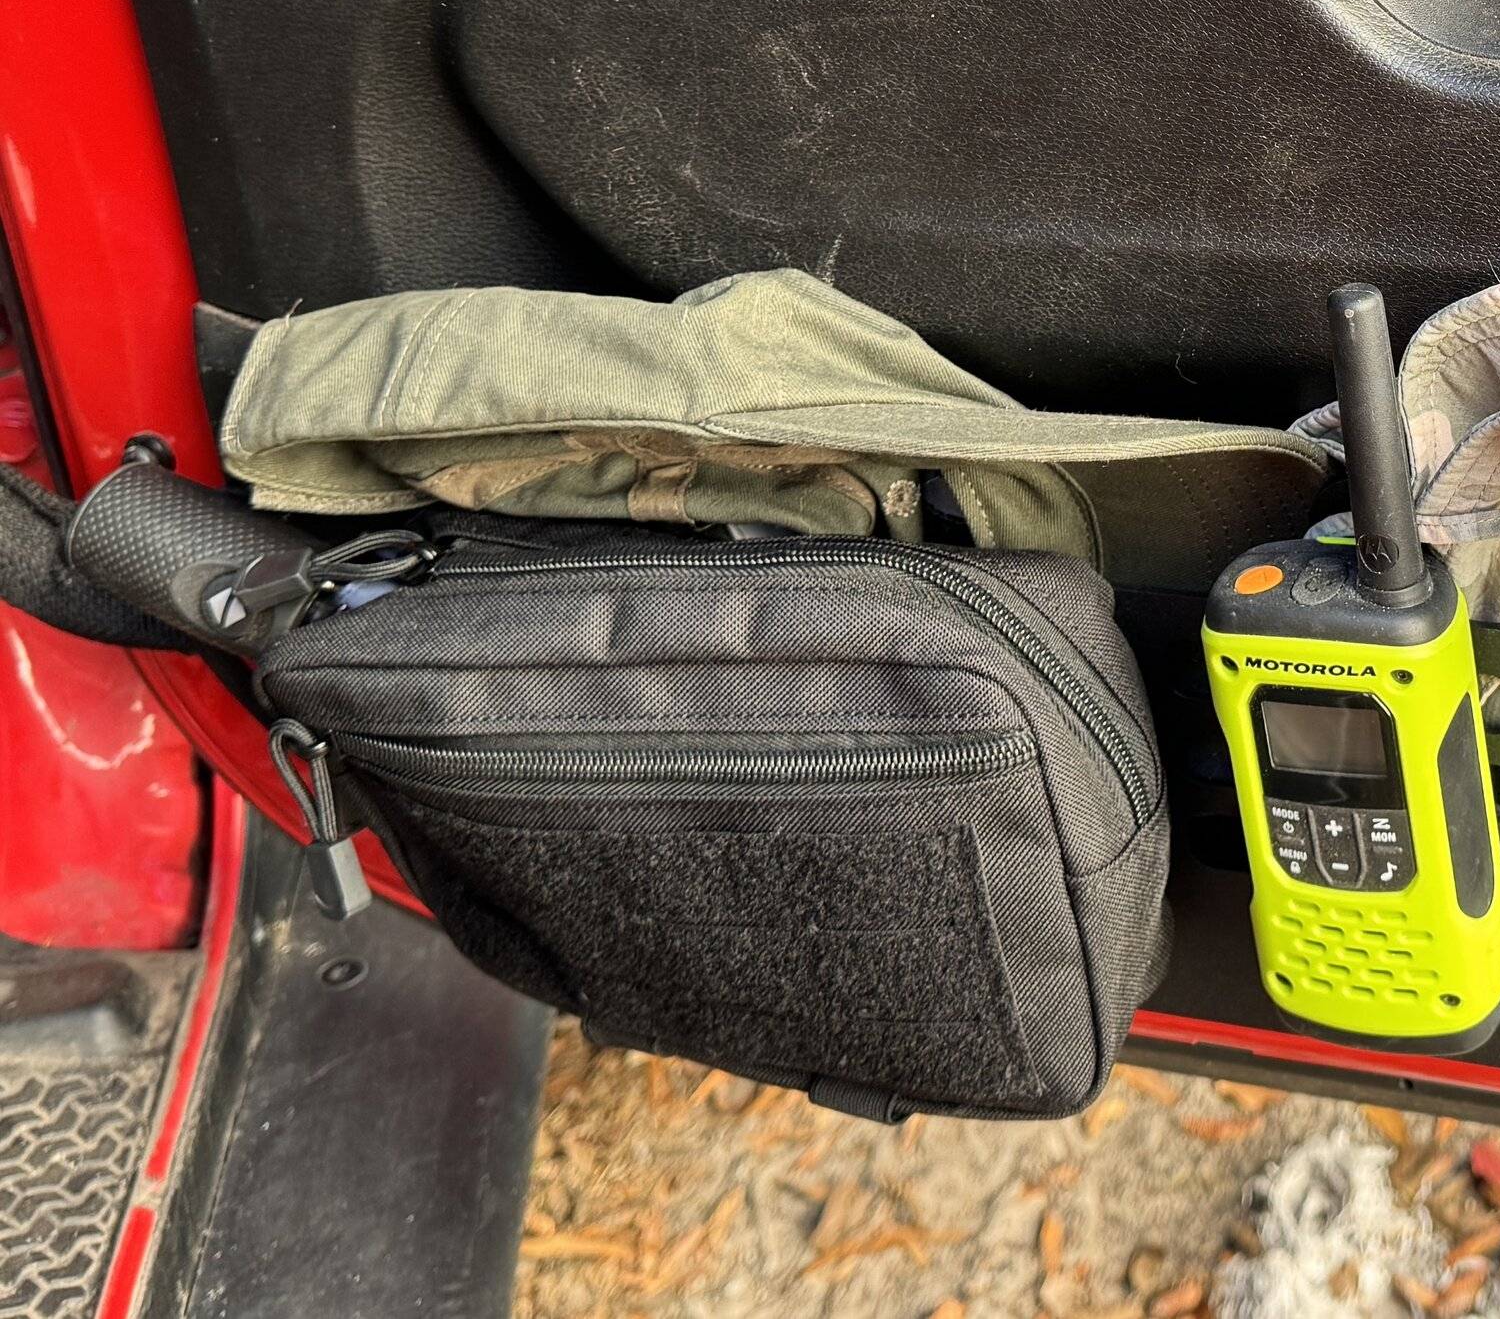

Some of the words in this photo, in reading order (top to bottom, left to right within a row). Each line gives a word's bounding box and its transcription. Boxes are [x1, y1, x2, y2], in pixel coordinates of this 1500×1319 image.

[1245, 656, 1377, 677] MOTOROLA
[1272, 807, 1300, 821] MODE
[1371, 832, 1397, 843] MON
[1279, 847, 1308, 862] MENU
